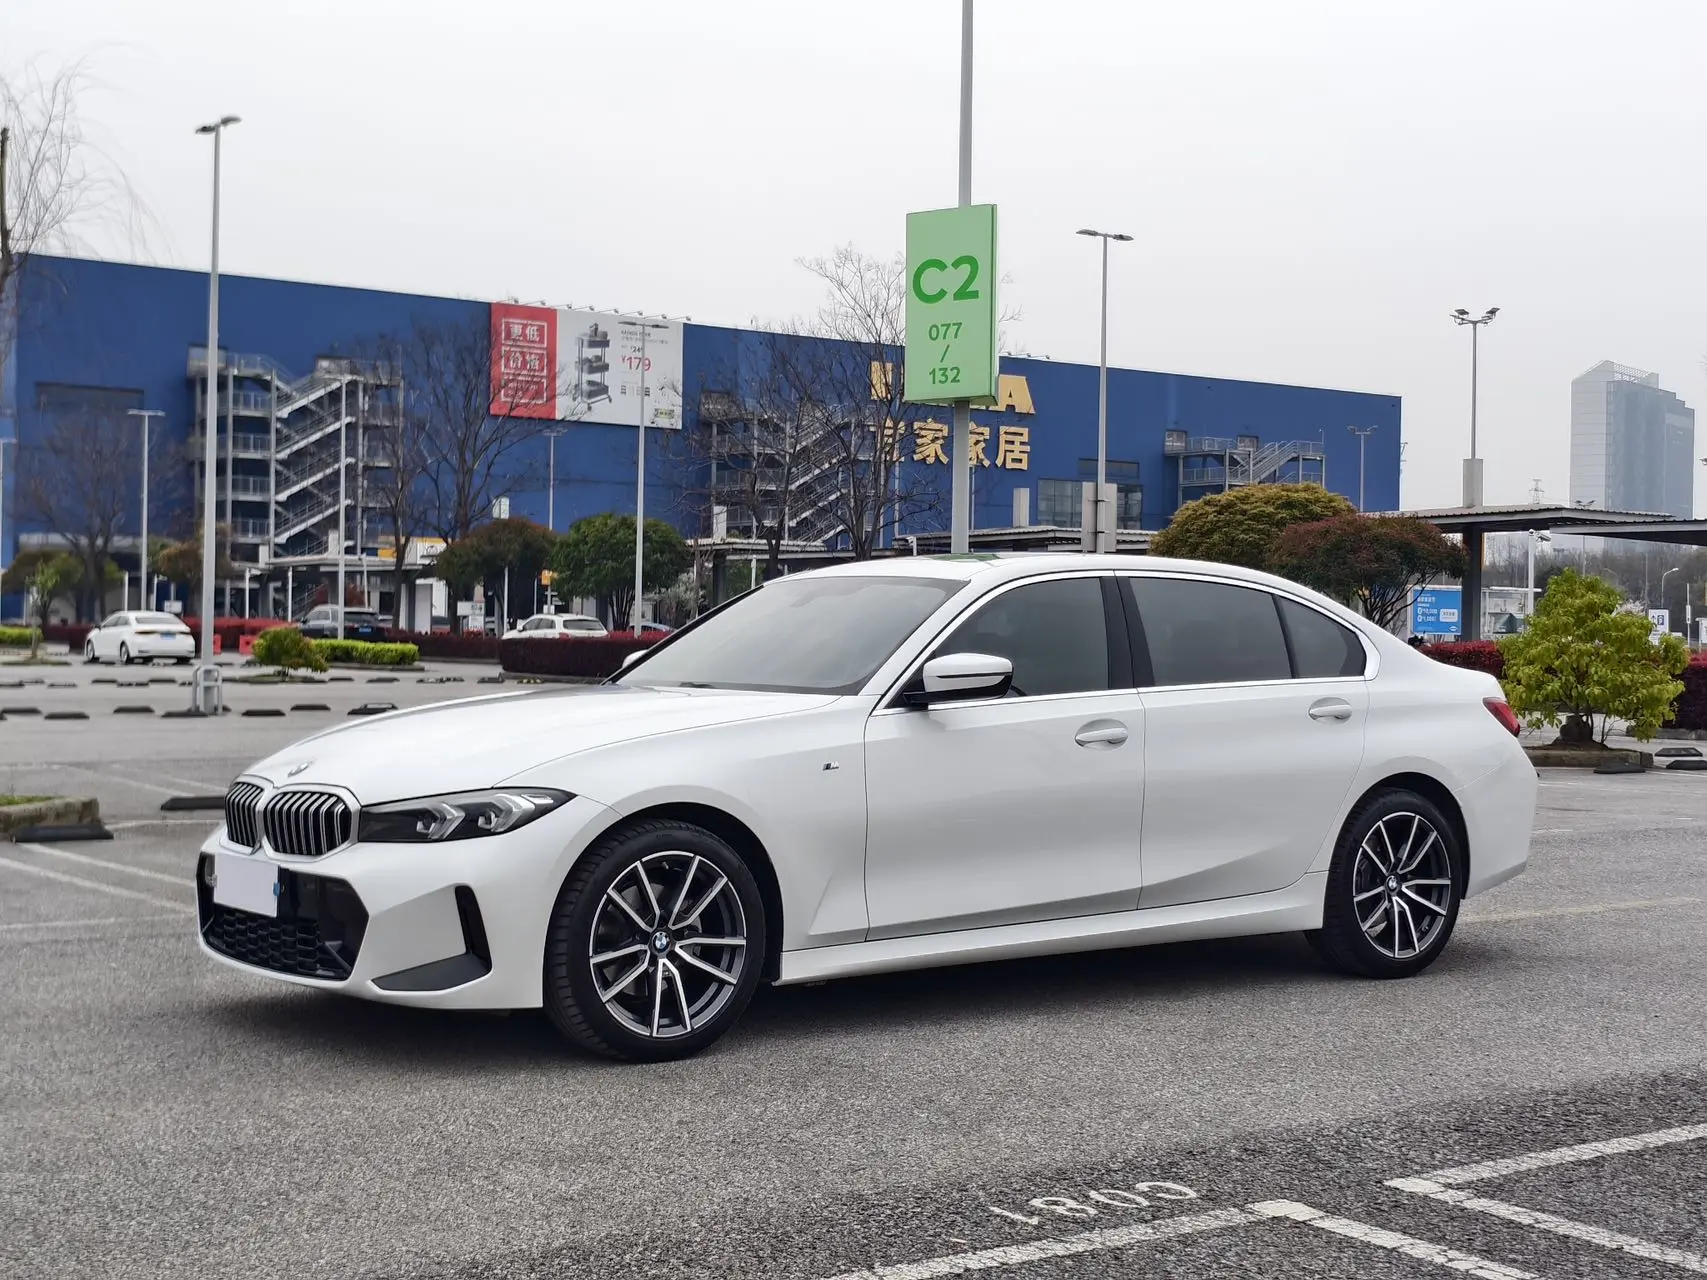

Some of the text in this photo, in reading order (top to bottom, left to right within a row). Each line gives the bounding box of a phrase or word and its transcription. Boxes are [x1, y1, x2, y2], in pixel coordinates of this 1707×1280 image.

[912, 255, 980, 304] C2
[928, 322, 963, 342] 077
[939, 344, 950, 363] /
[928, 366, 962, 385] 132
[870, 360, 1037, 414] IA
